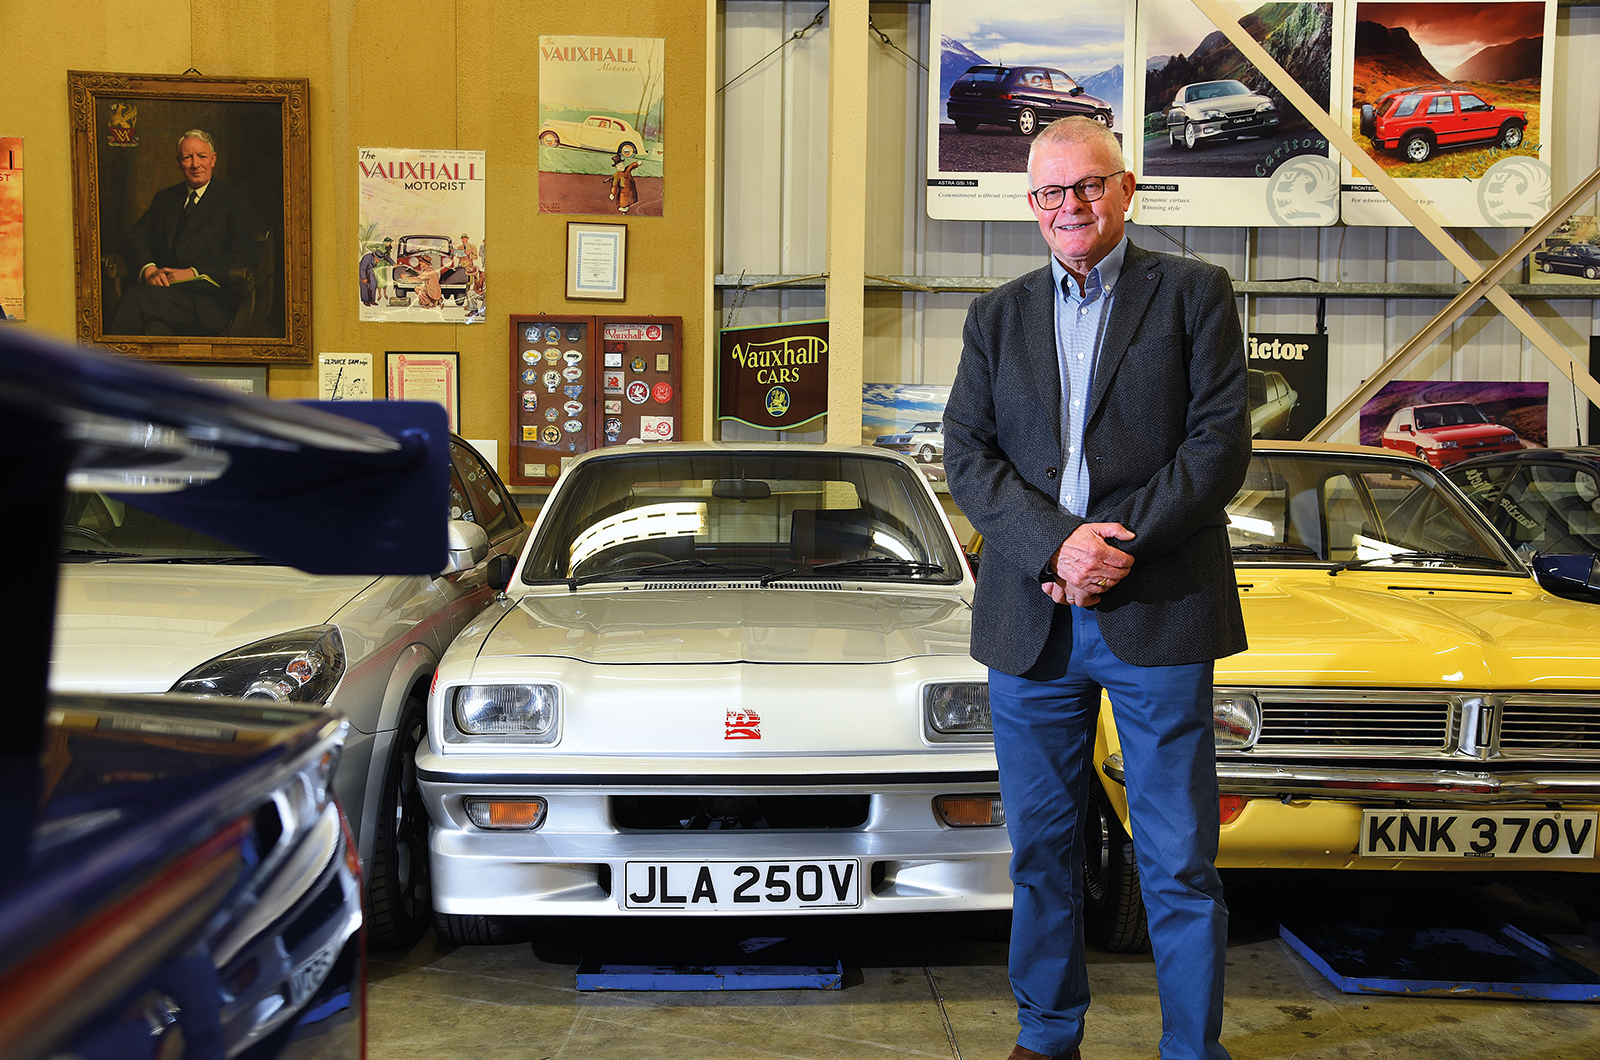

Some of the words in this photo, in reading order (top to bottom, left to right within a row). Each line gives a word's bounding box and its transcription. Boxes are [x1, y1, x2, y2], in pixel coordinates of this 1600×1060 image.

[541, 47, 637, 63] VAUXHALL
[598, 63, 636, 72] Motorist
[361, 150, 375, 160] The
[1255, 139, 1326, 177] Carlton
[1463, 140, 1543, 182] Frontera
[359, 161, 483, 180] VAUXHALL
[404, 181, 466, 191] MOTORIST
[606, 328, 644, 339] Vauxhall
[732, 336, 828, 368] Vauxhall
[1249, 338, 1309, 360] ictor
[757, 367, 799, 384] CARS
[1368, 816, 1458, 852] KNK
[1469, 817, 1592, 854] 370V
[629, 866, 717, 903] JLA
[733, 864, 854, 903] 250V
